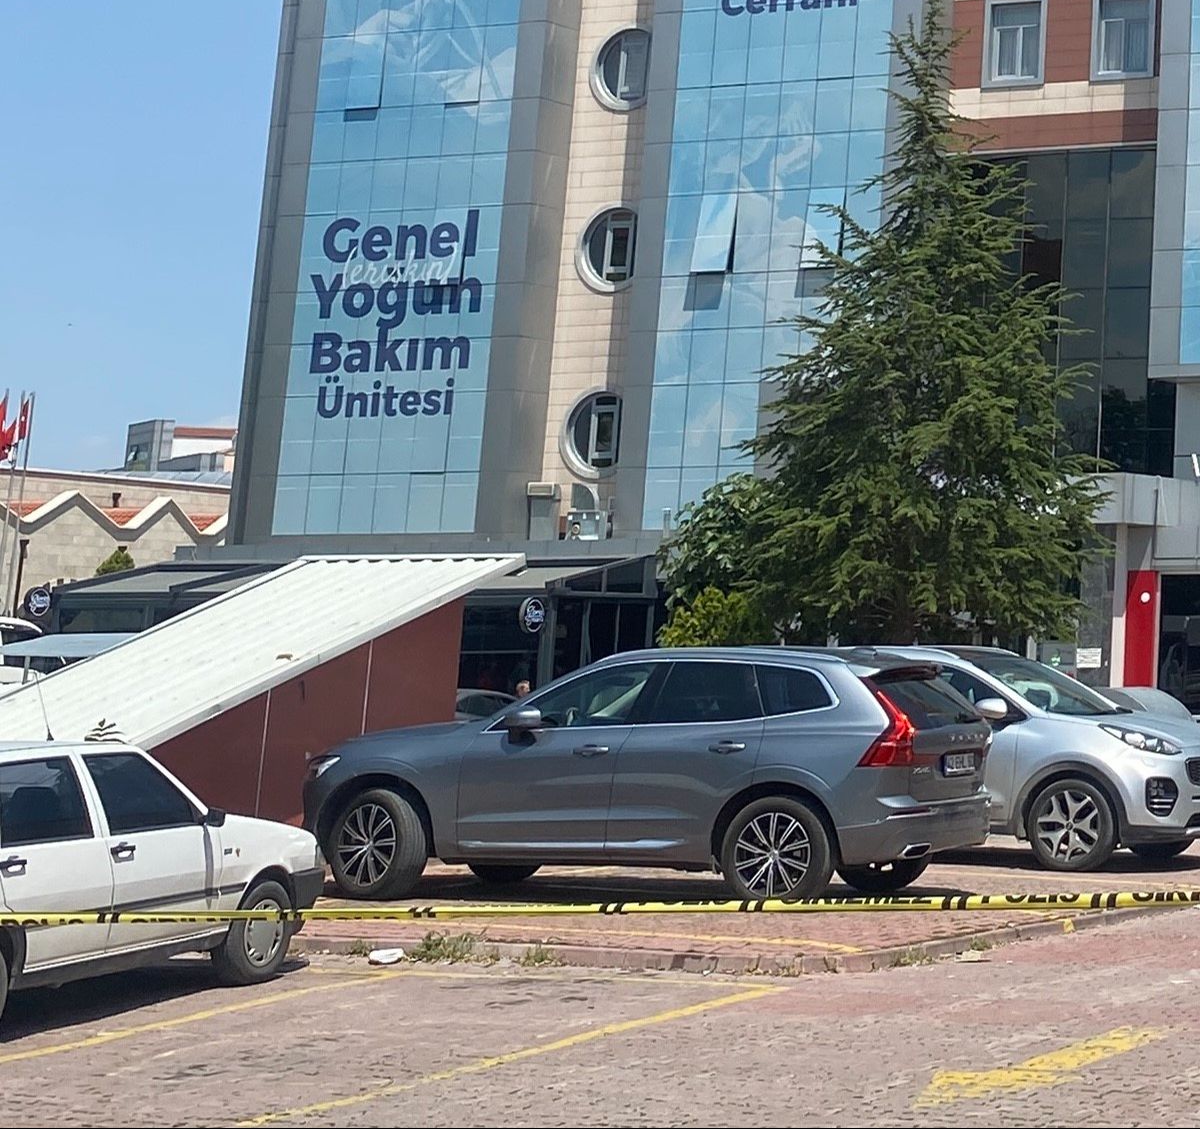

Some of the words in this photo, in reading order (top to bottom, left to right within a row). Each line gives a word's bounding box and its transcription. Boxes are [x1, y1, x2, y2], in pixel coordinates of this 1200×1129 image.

[322, 209, 480, 263] Genel
[310, 267, 482, 330] Yoğun
[309, 328, 471, 374] Bakım
[317, 375, 455, 419] Ünitesi
